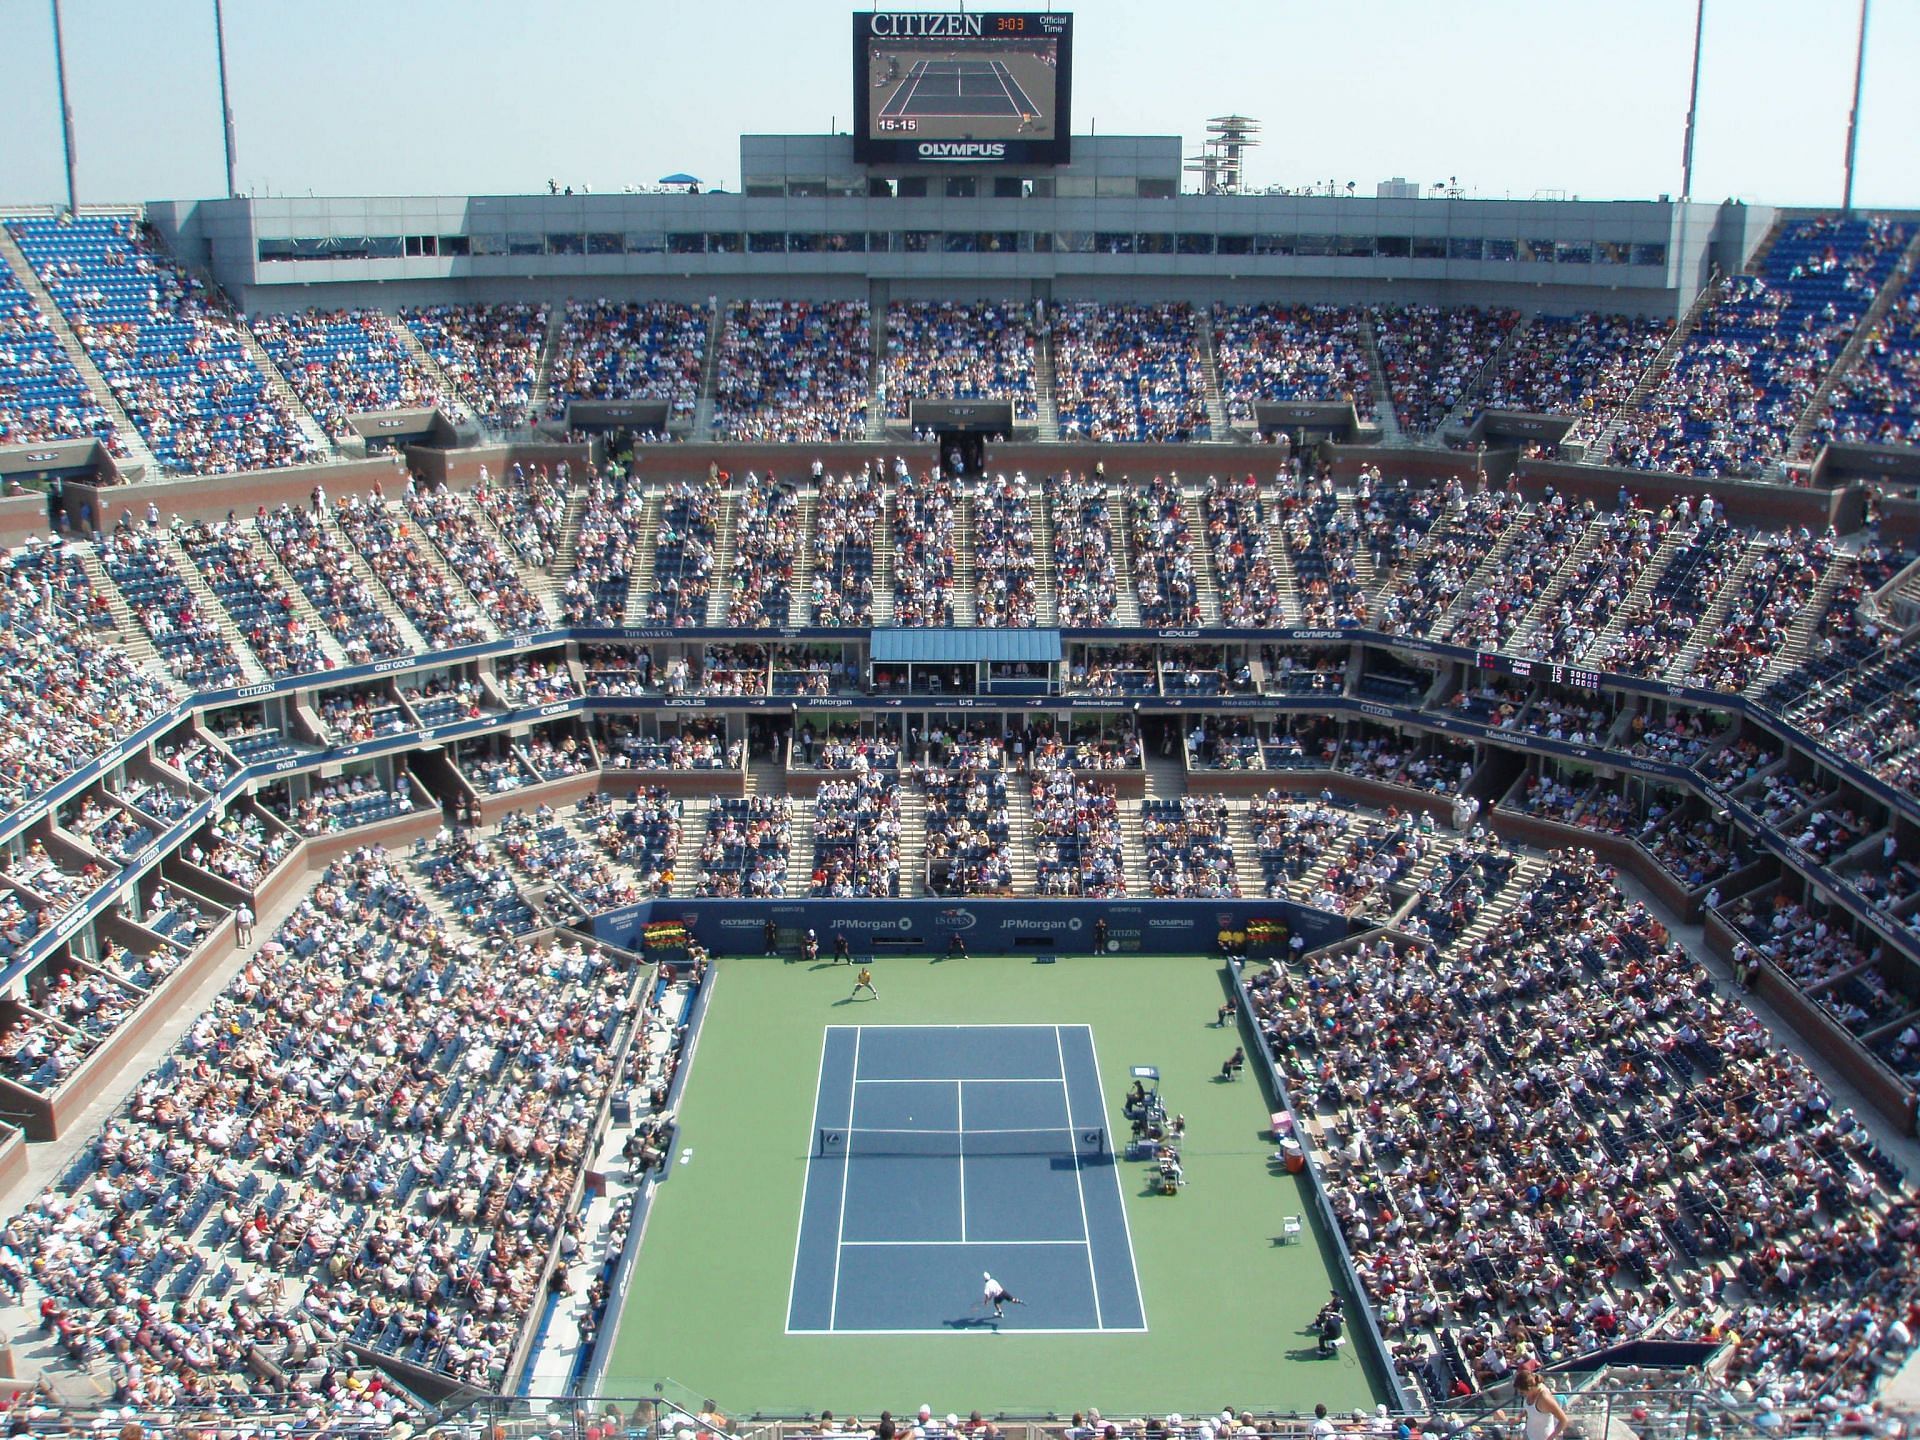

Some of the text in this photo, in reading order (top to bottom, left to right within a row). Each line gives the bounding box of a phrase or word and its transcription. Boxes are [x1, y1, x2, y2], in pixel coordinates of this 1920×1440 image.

[871, 14, 984, 36] CITIZEN
[998, 18, 1024, 31] 3:03
[1039, 16, 1067, 25] Official
[1043, 24, 1063, 33] Time
[879, 119, 916, 130] 15-15
[918, 143, 1004, 156] OLYMPUS
[1158, 630, 1200, 638] LEXUS
[1292, 631, 1343, 639] OLYMPUS
[513, 636, 533, 648] IBM
[1552, 666, 1562, 675] 15
[1551, 675, 1561, 683] 15
[237, 683, 276, 698] CITIZEN
[540, 704, 569, 716] Canon
[1360, 704, 1393, 717] CITIZEN
[276, 759, 297, 771] evian
[829, 919, 896, 930] JPMorgan
[1000, 919, 1066, 930] JPMorgan
[1107, 929, 1141, 937] CITIZEN
